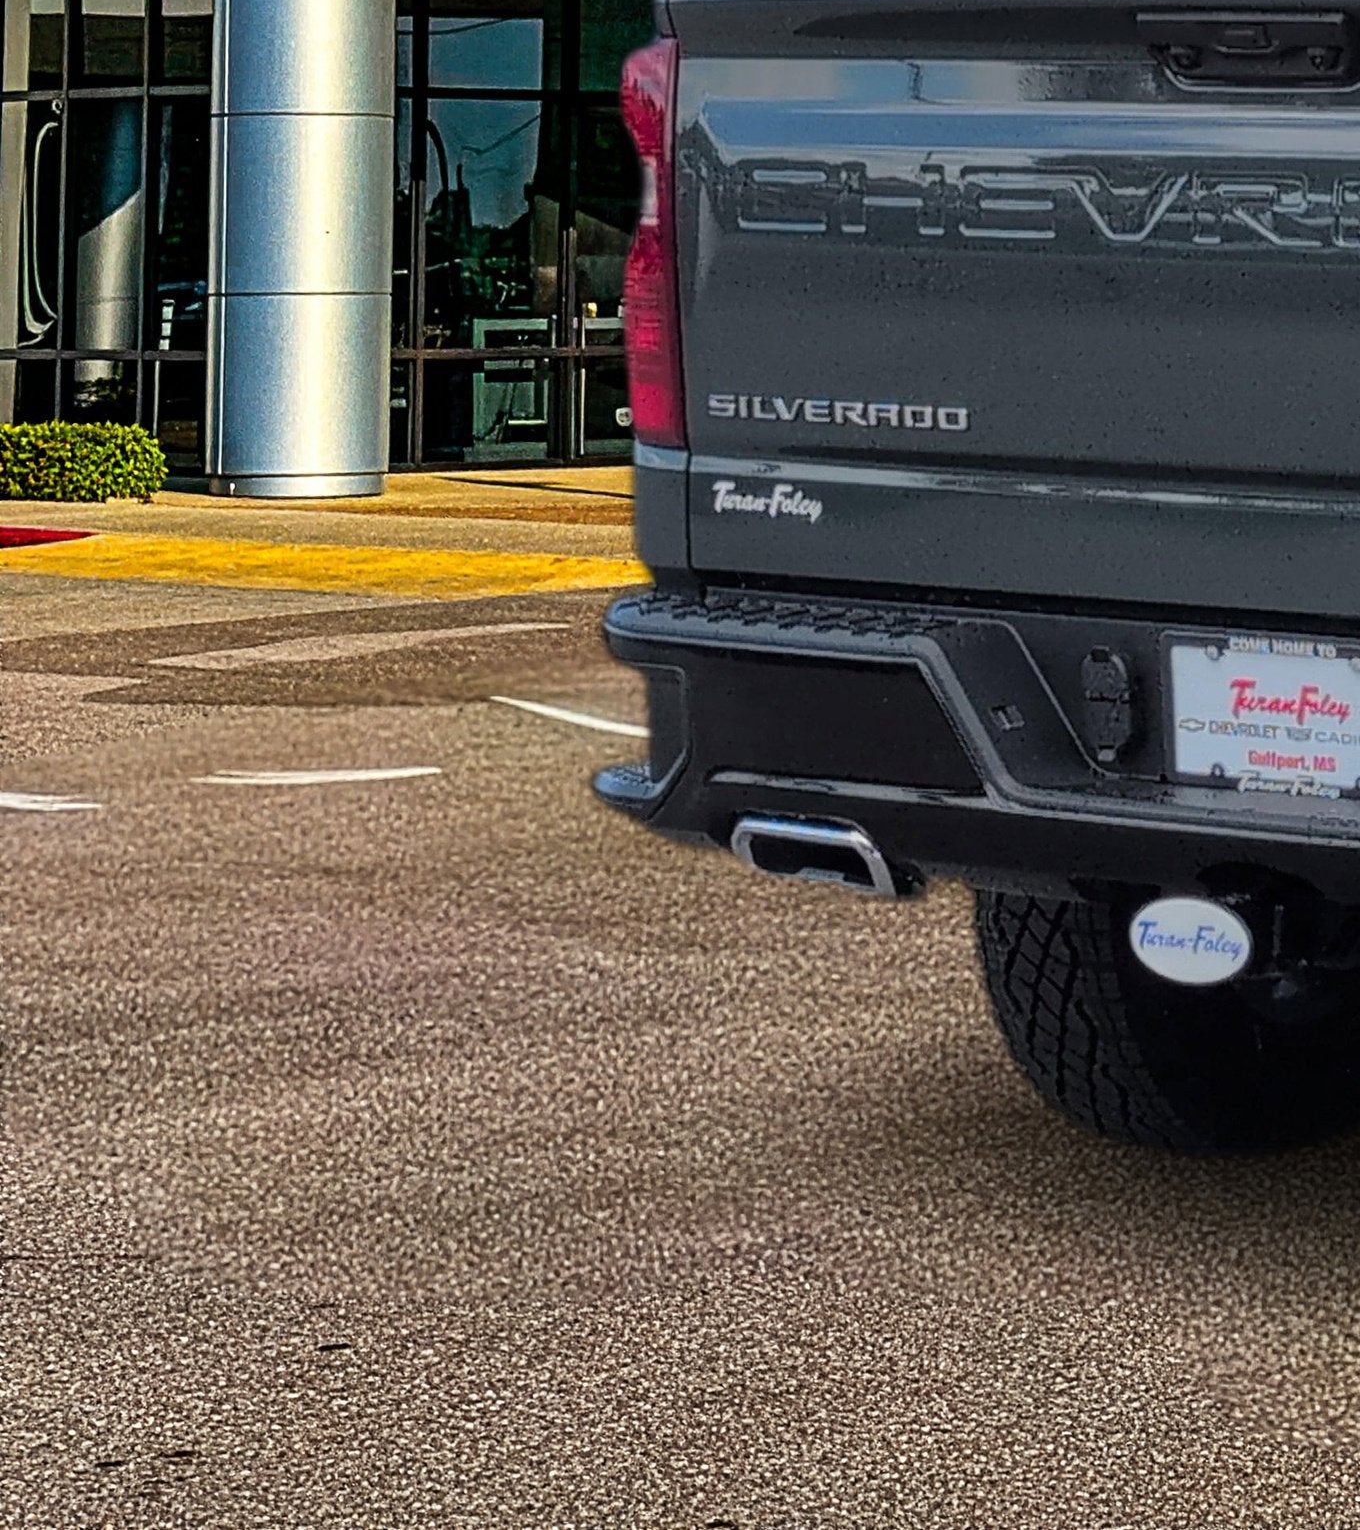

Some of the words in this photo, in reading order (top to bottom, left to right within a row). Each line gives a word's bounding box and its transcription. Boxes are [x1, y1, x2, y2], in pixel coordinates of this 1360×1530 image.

[708, 393, 970, 431] SILVERADO
[1209, 720, 1280, 740] CHEVROLET
[1248, 750, 1309, 771] Gulfport,
[1313, 756, 1336, 772] MS
